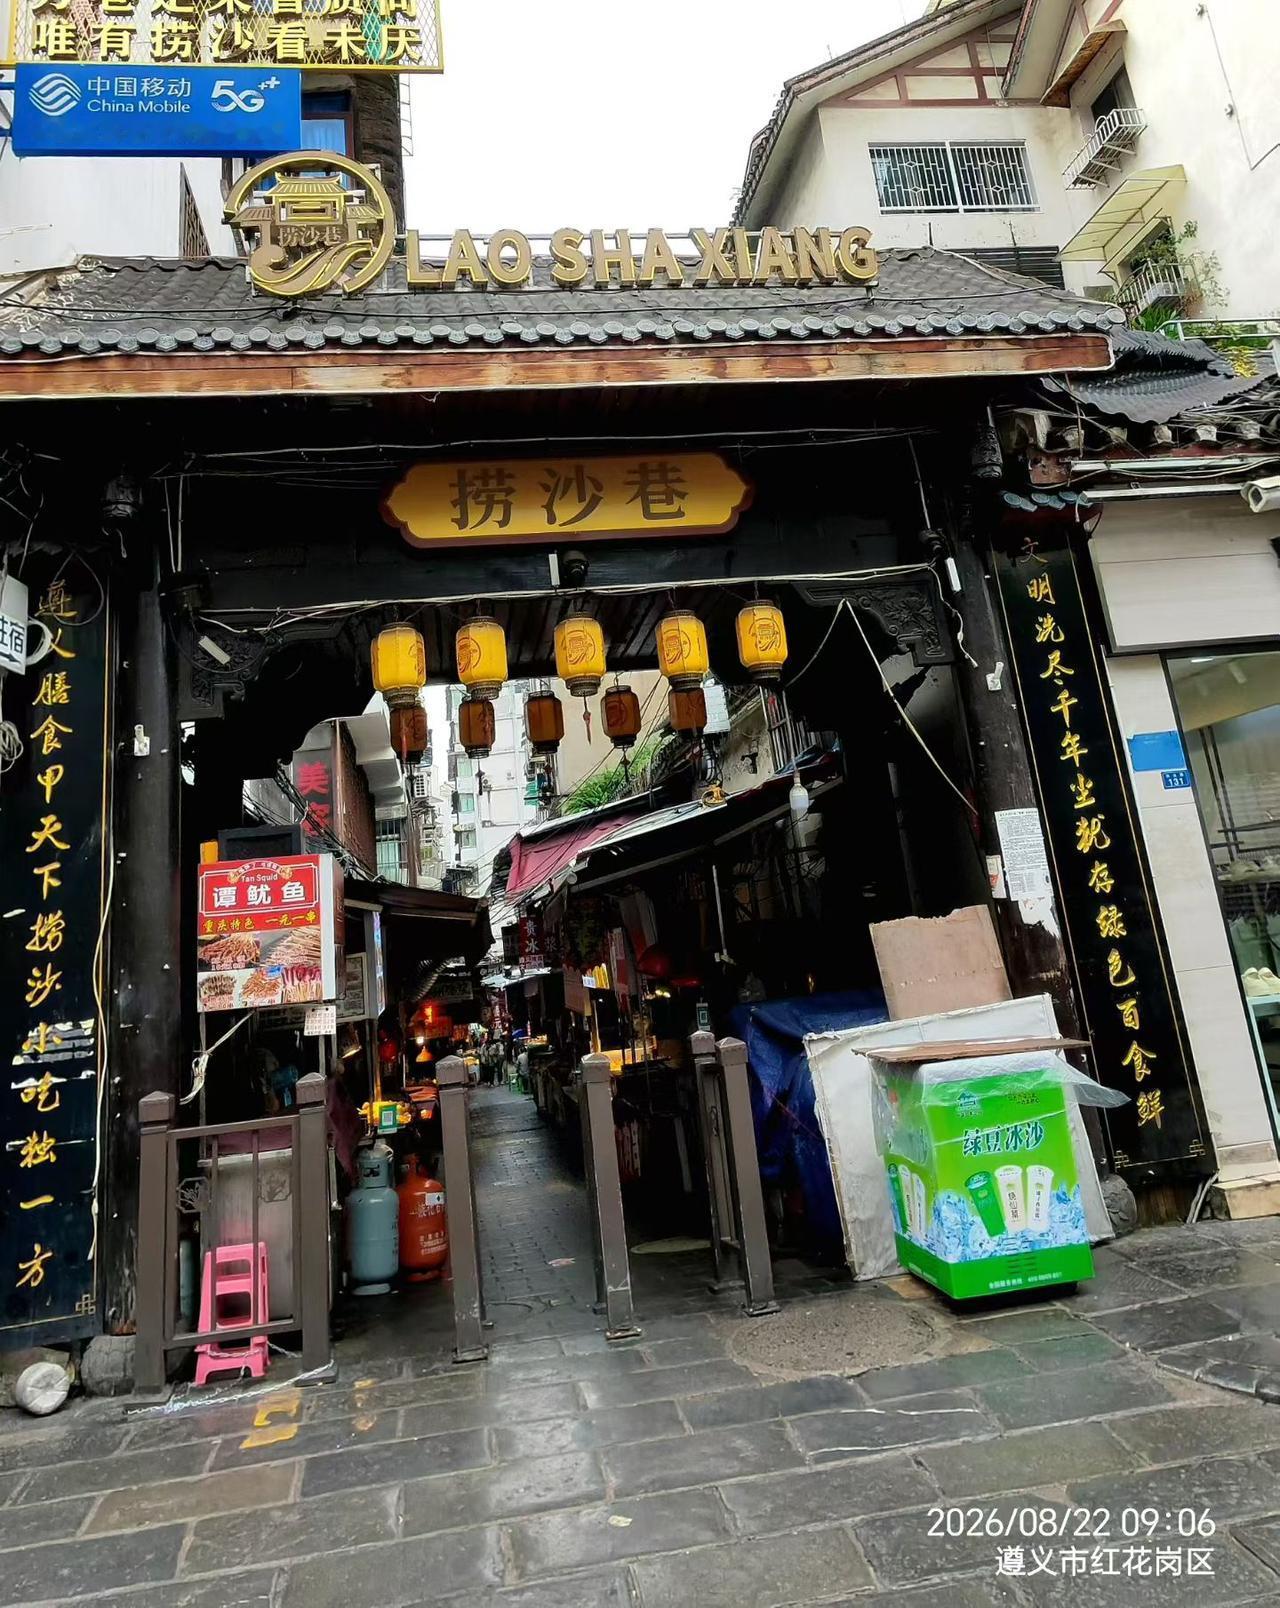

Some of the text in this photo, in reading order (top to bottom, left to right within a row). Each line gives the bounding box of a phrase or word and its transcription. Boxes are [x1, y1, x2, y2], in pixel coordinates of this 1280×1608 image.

[87, 76, 191, 98] 中国移动
[87, 99, 191, 113] China Mobile
[406, 225, 879, 288] LAO SHA XIANG
[449, 460, 690, 531] 捞沙巷
[1168, 777, 1184, 787] 131
[241, 873, 279, 883] Tan Squid
[212, 880, 306, 908] 谭鱿鱼
[203, 916, 255, 932] 重庆特色
[265, 909, 317, 927] 一元一串
[963, 1120, 1044, 1156] 绿豆冰沙
